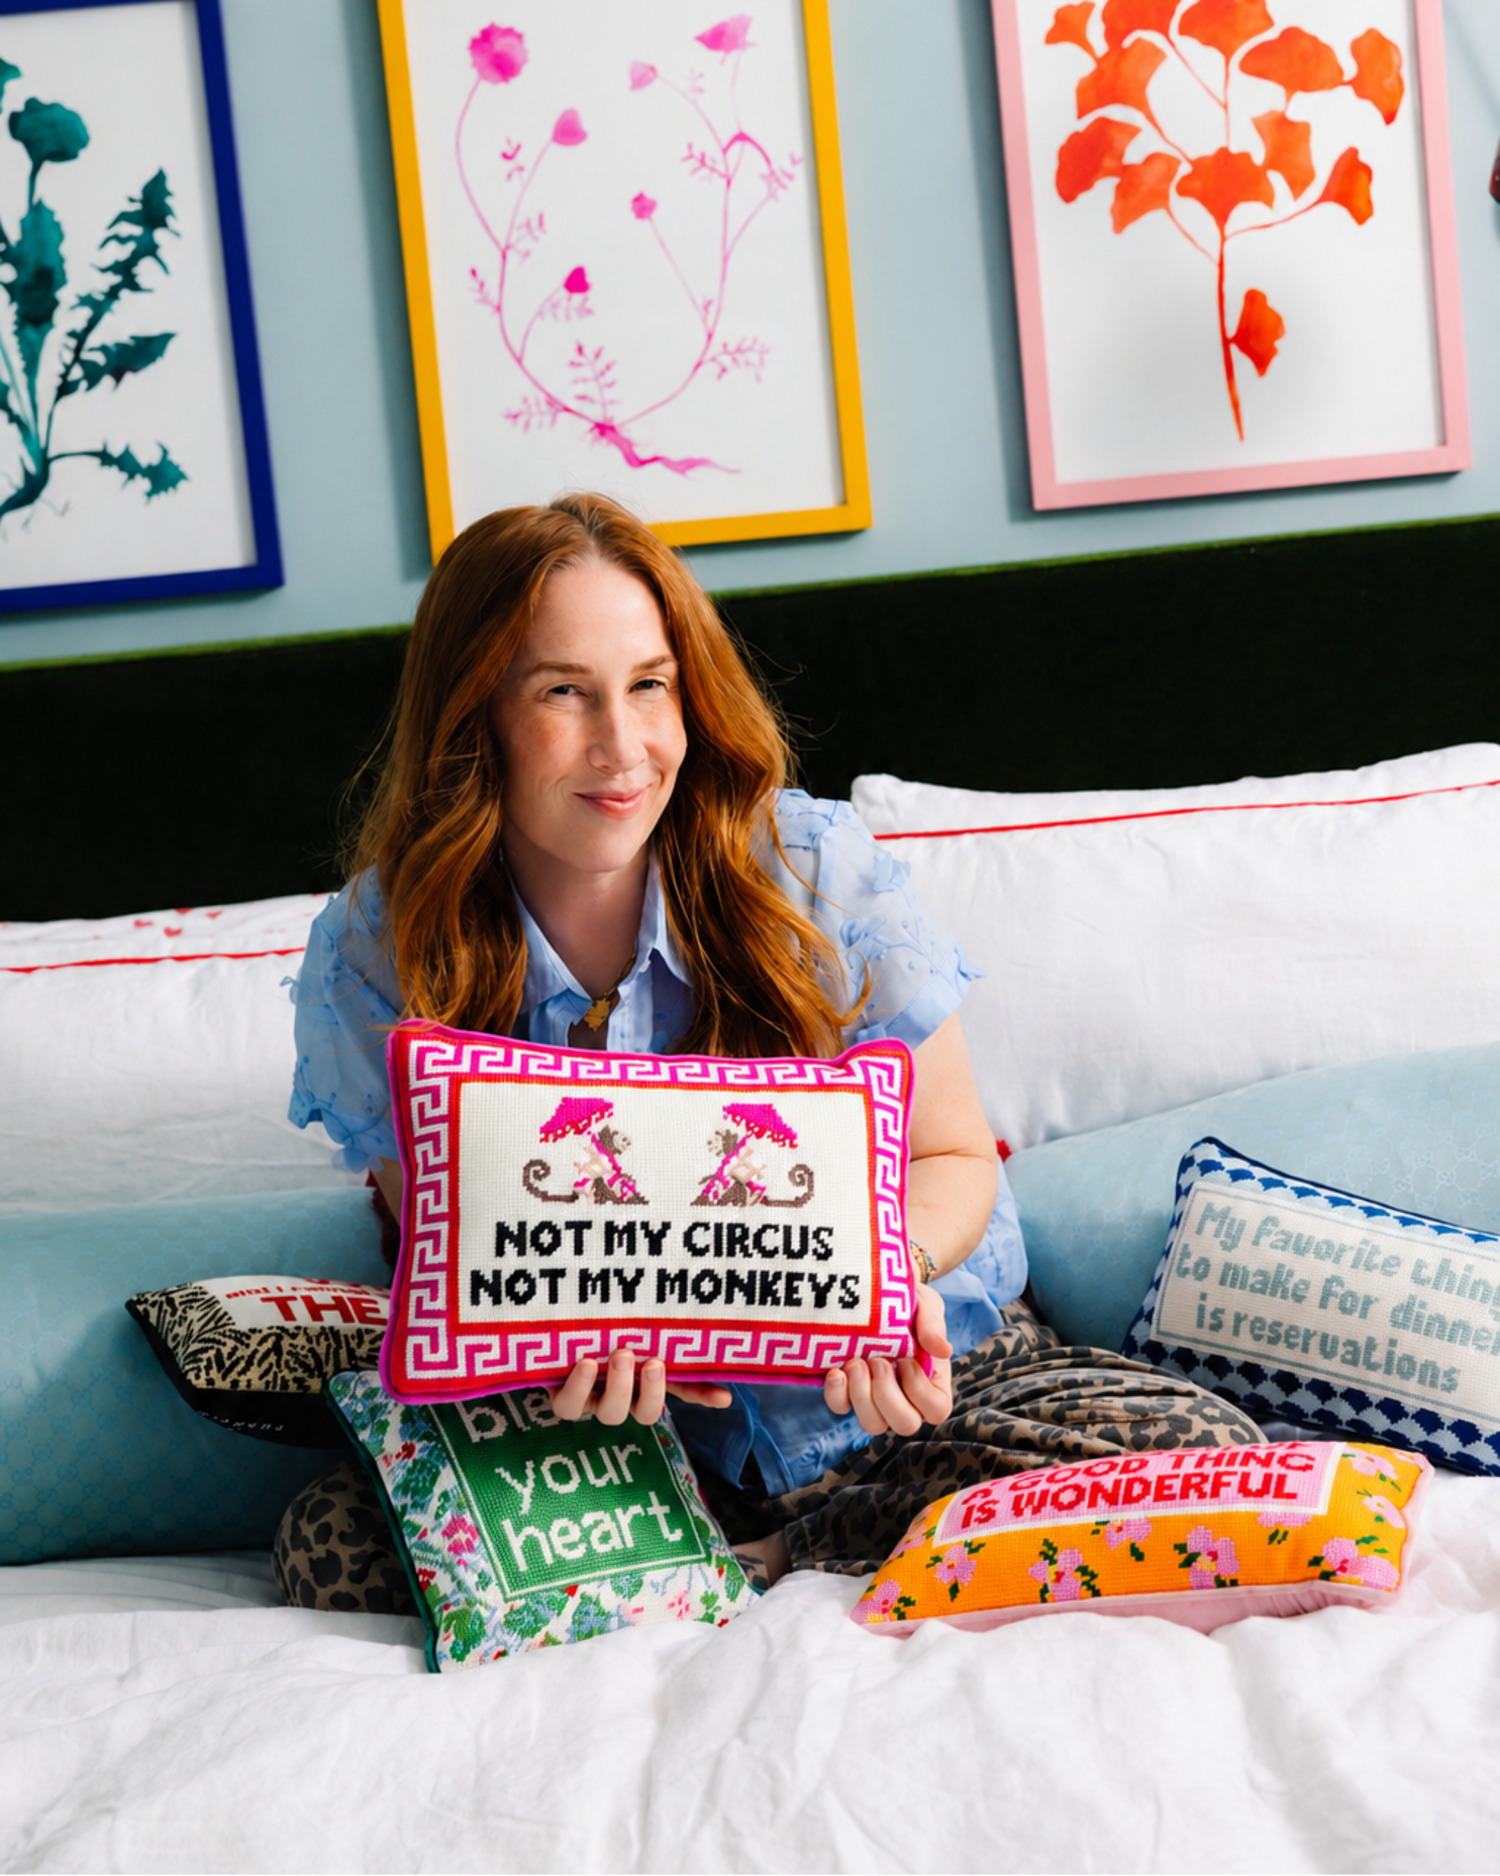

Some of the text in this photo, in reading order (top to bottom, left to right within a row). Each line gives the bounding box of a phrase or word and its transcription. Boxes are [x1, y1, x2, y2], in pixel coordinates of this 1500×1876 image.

[495, 1221, 834, 1260] NOT MY CIRCUS
[1195, 1202, 1247, 1253] My
[1251, 1214, 1404, 1277] favorite
[260, 1295, 388, 1325] THE
[470, 1268, 860, 1309] NOT MY MONKEYS
[1175, 1243, 1211, 1281] to
[1218, 1262, 1311, 1304] make
[1318, 1274, 1380, 1320] for
[1195, 1292, 1461, 1393] is reservations
[455, 1391, 593, 1442] ble
[495, 1444, 642, 1515] your
[961, 1471, 1298, 1529] IS WONDERFUL
[1009, 1458, 1149, 1491] GOOD
[1168, 1451, 1316, 1472] THING
[502, 1491, 683, 1572] heart
